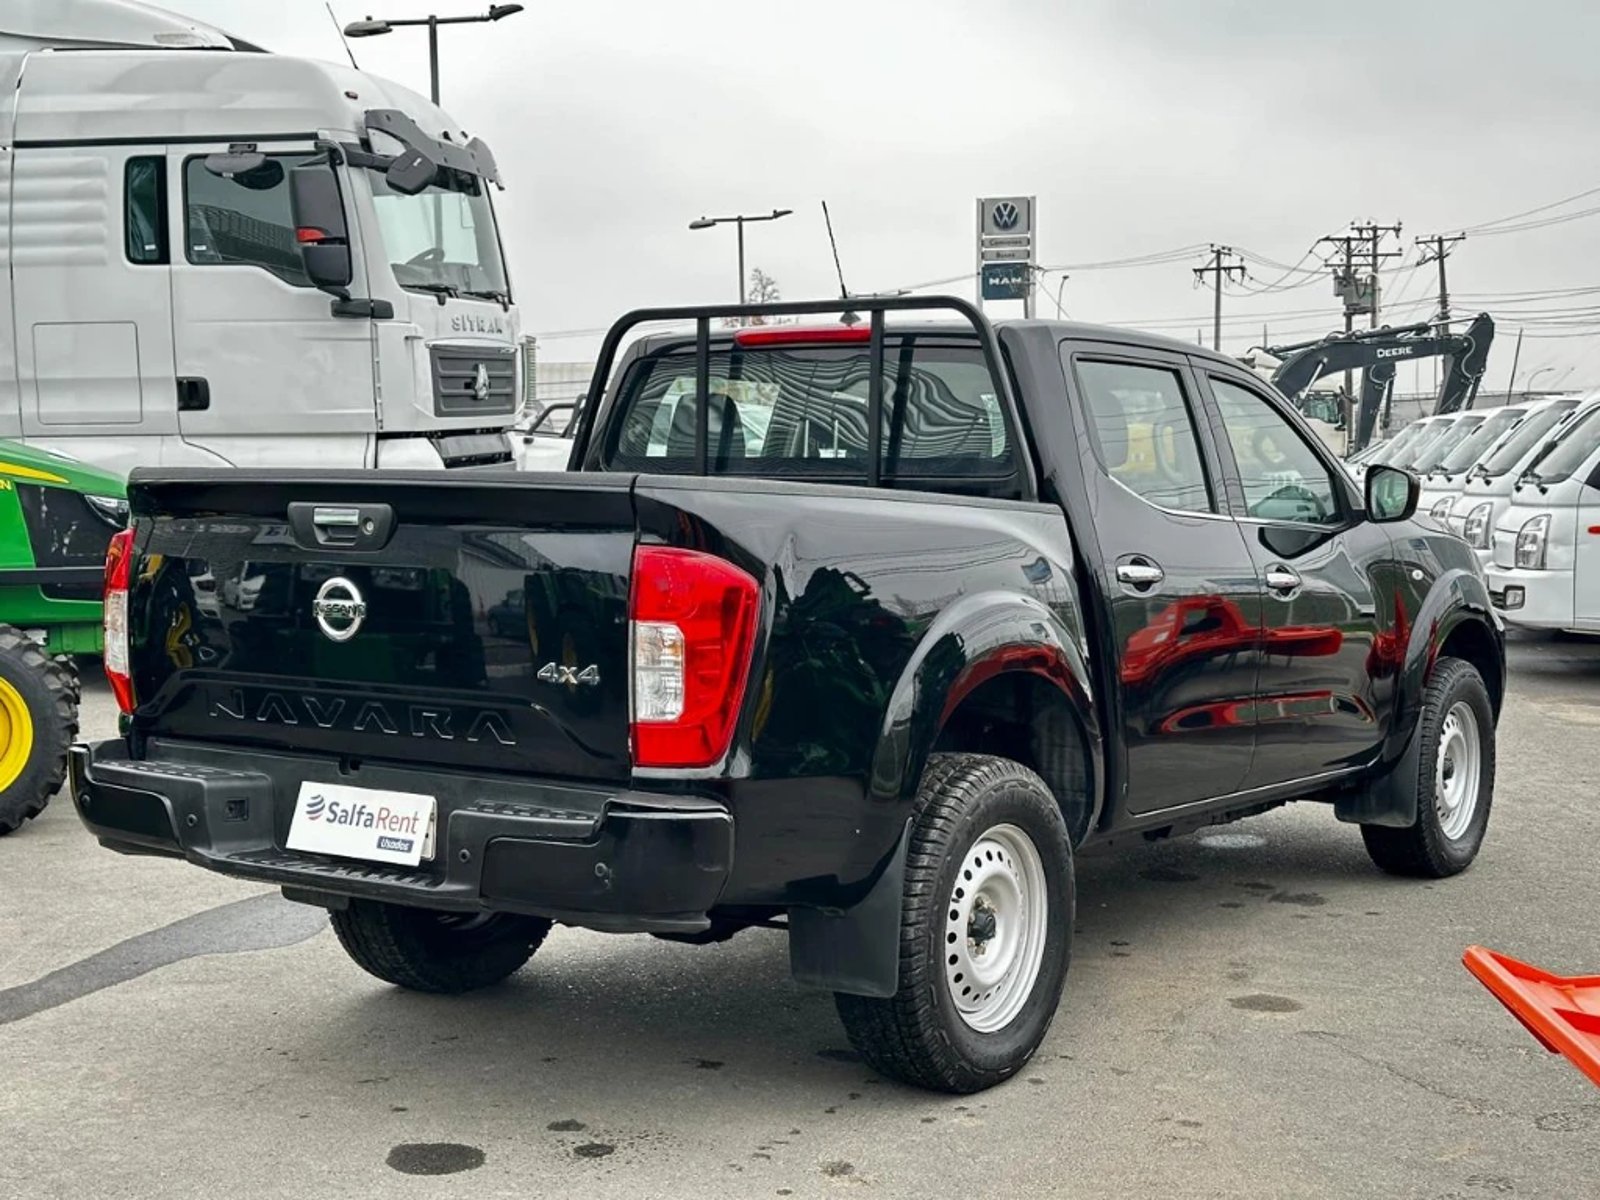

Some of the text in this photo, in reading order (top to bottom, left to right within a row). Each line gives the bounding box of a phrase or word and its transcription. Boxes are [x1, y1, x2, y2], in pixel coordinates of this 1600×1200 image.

[1376, 346, 1412, 358] DEERE
[313, 601, 362, 618] NISSAN
[537, 662, 600, 686] 4x4
[210, 689, 516, 744] NAVARA
[326, 801, 419, 834] SalfaRent
